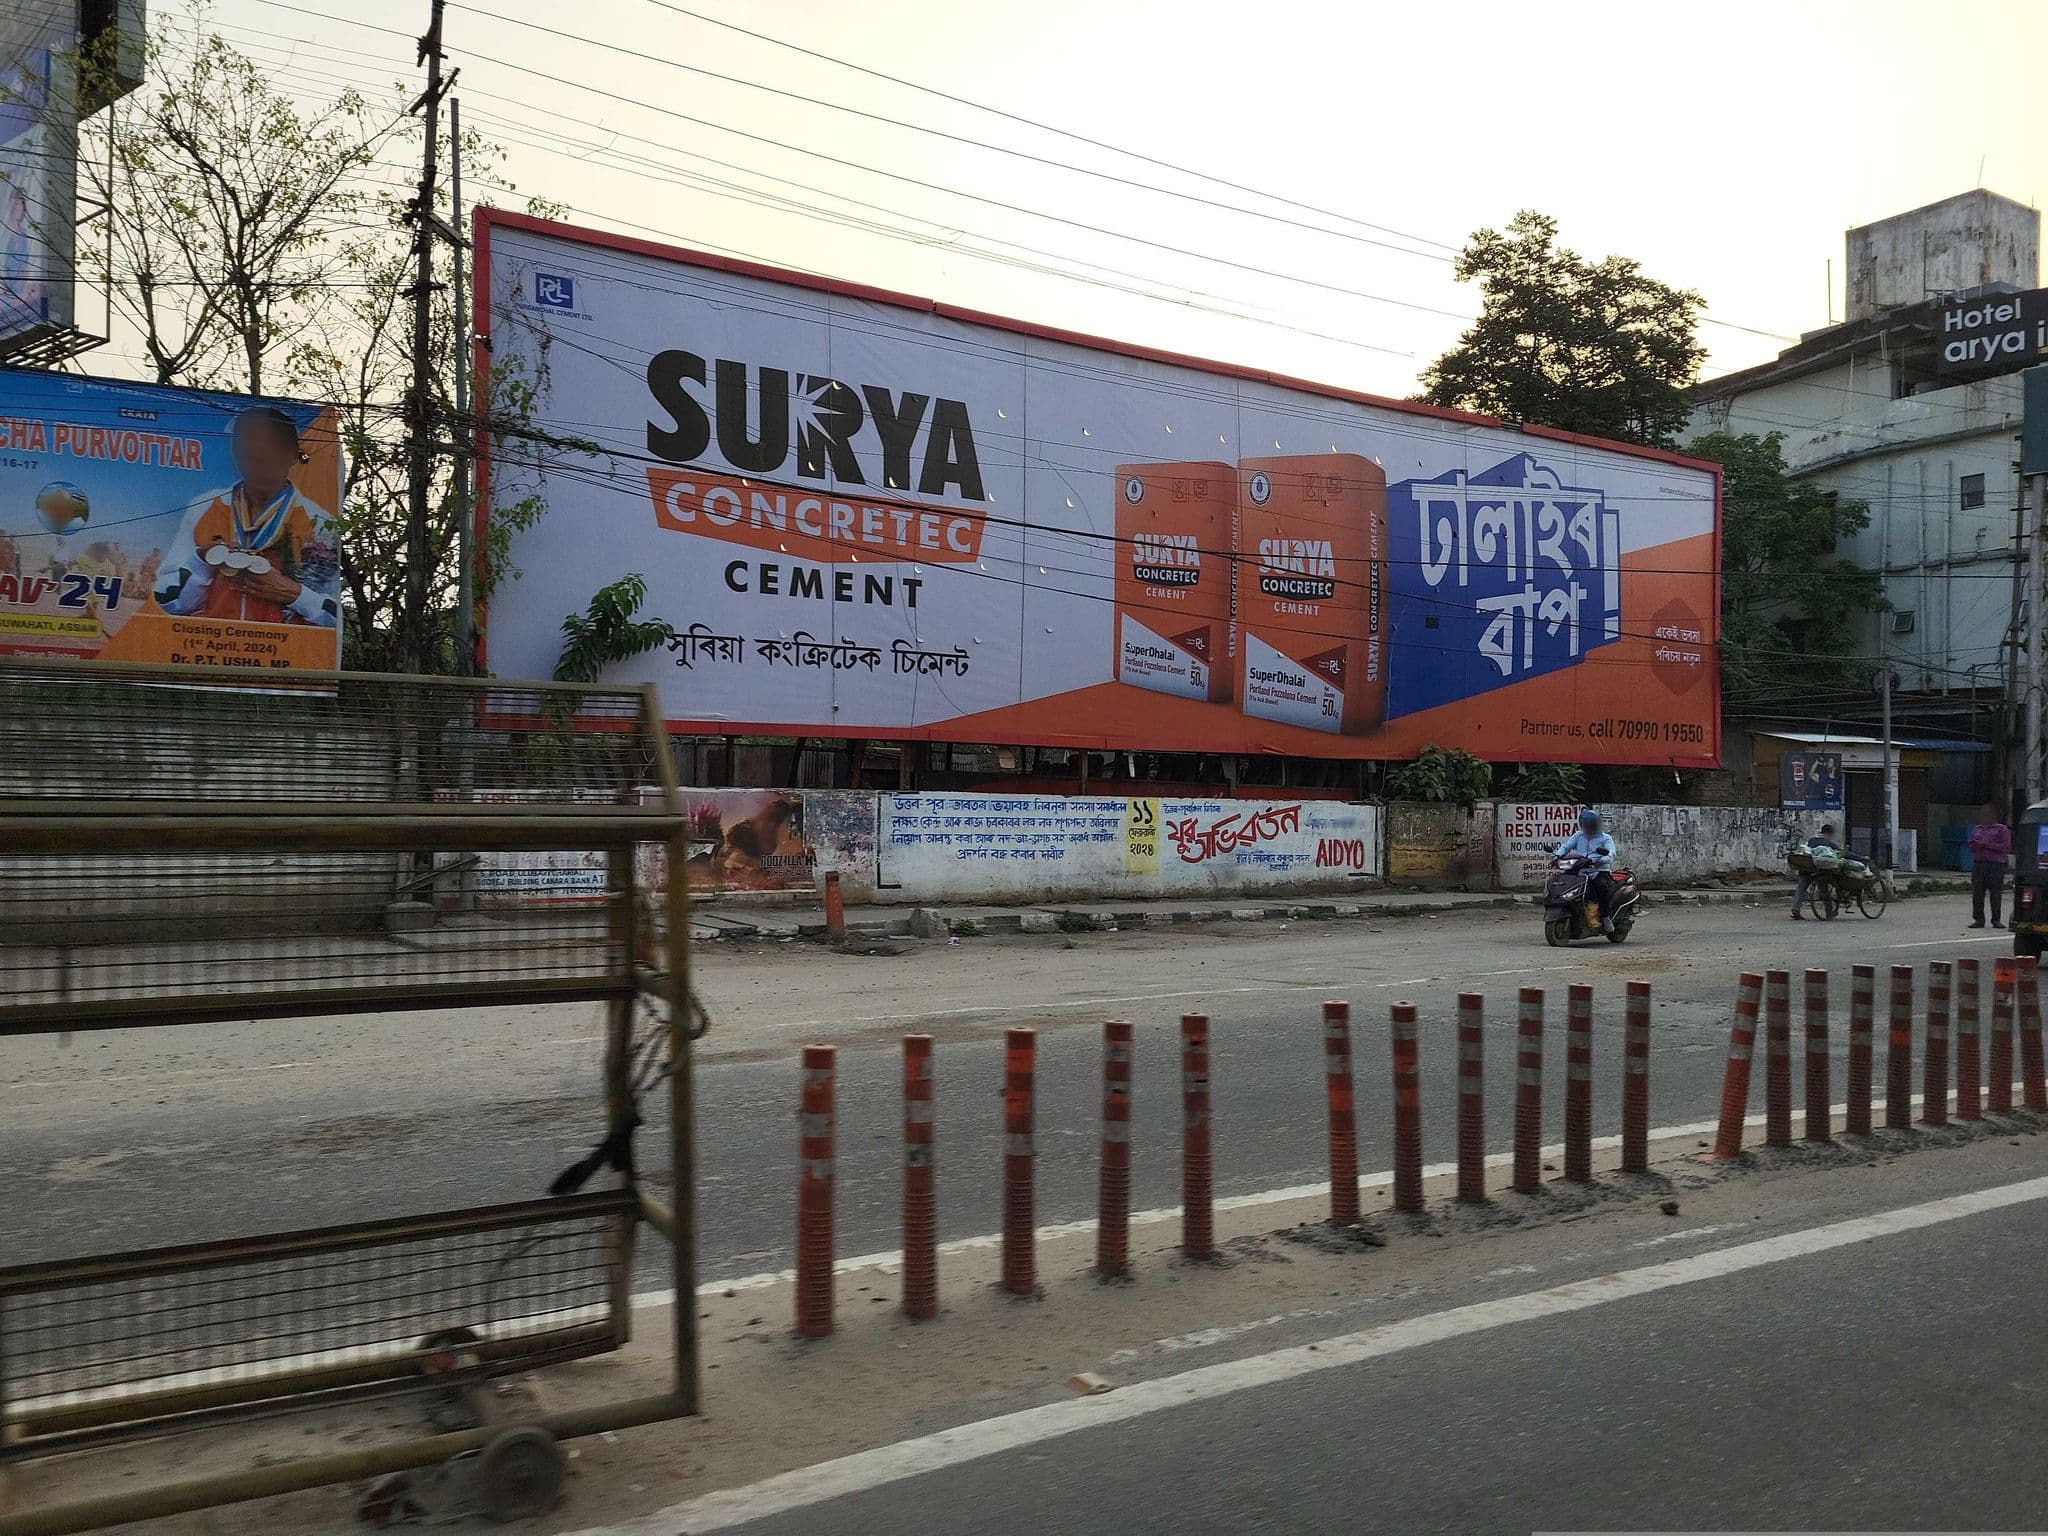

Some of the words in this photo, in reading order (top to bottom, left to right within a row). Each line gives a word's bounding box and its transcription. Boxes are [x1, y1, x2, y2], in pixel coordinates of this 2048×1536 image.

[1944, 298, 2021, 332] Hotel
[1944, 330, 2025, 363] arya
[2037, 320, 2048, 347] i
[647, 350, 986, 501] SURYA
[53, 421, 203, 472] PURVOTTAR
[665, 481, 973, 554] CONCRETEC
[1133, 533, 1200, 567] SURYA
[1258, 538, 1336, 577] SURYA
[725, 560, 923, 608] CEMENT
[1135, 568, 1198, 584] CONCRETEC
[1145, 586, 1187, 600] CEMENT
[1262, 579, 1333, 597] CONCRETEC
[1370, 562, 1379, 631] CONCRETEC
[1274, 602, 1320, 616] CEMENT
[58, 622, 98, 632] ASS
[172, 623, 221, 637] Closing
[225, 627, 289, 642] Ceremony
[1125, 642, 1175, 661] SuperDhalai
[1250, 667, 1306, 688] SuperDhalai
[1520, 718, 1565, 737] Partner
[1567, 723, 1585, 739] us,
[1588, 719, 1614, 738] call
[1618, 720, 1658, 741] 70990
[1663, 722, 1703, 743] 19550
[1515, 806, 1538, 820] SRI
[1505, 823, 1580, 838] RESTAURA
[1316, 838, 1364, 869] AIDYO
[1510, 842, 1522, 851] NO
